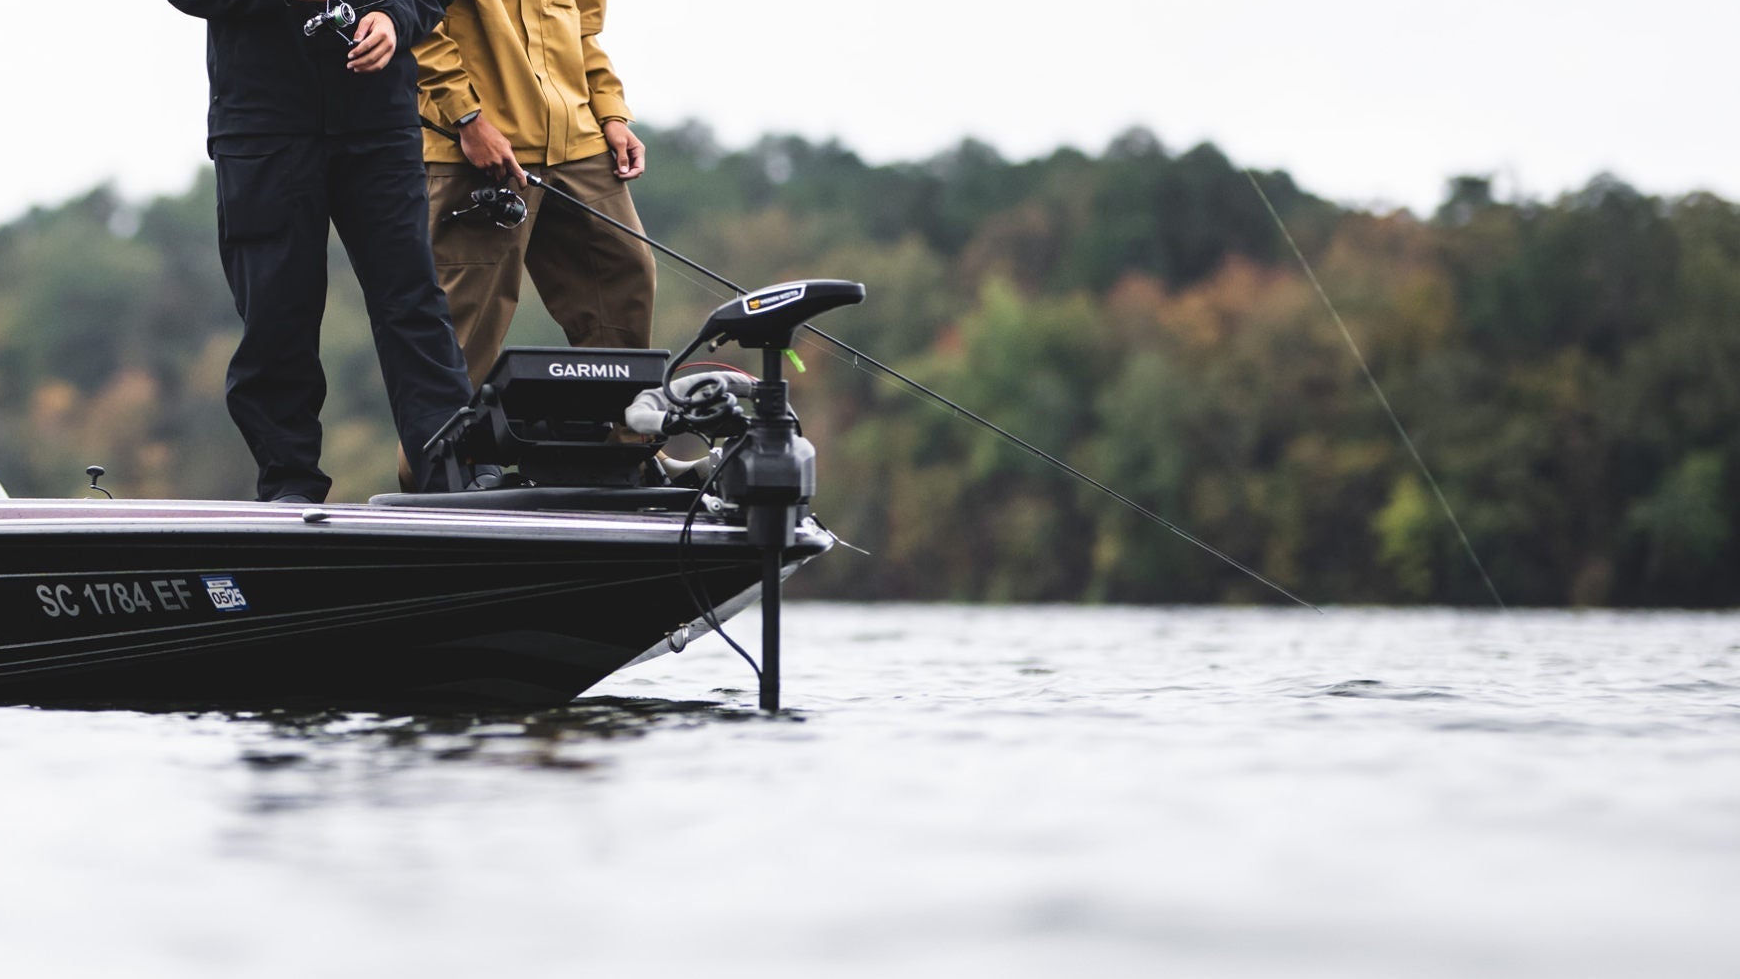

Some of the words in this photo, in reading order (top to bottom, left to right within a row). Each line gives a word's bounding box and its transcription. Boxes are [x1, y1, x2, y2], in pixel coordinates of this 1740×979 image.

[548, 362, 630, 378] GARMIN
[35, 583, 80, 617] SC
[83, 581, 152, 614] 1784
[150, 579, 192, 610] EF
